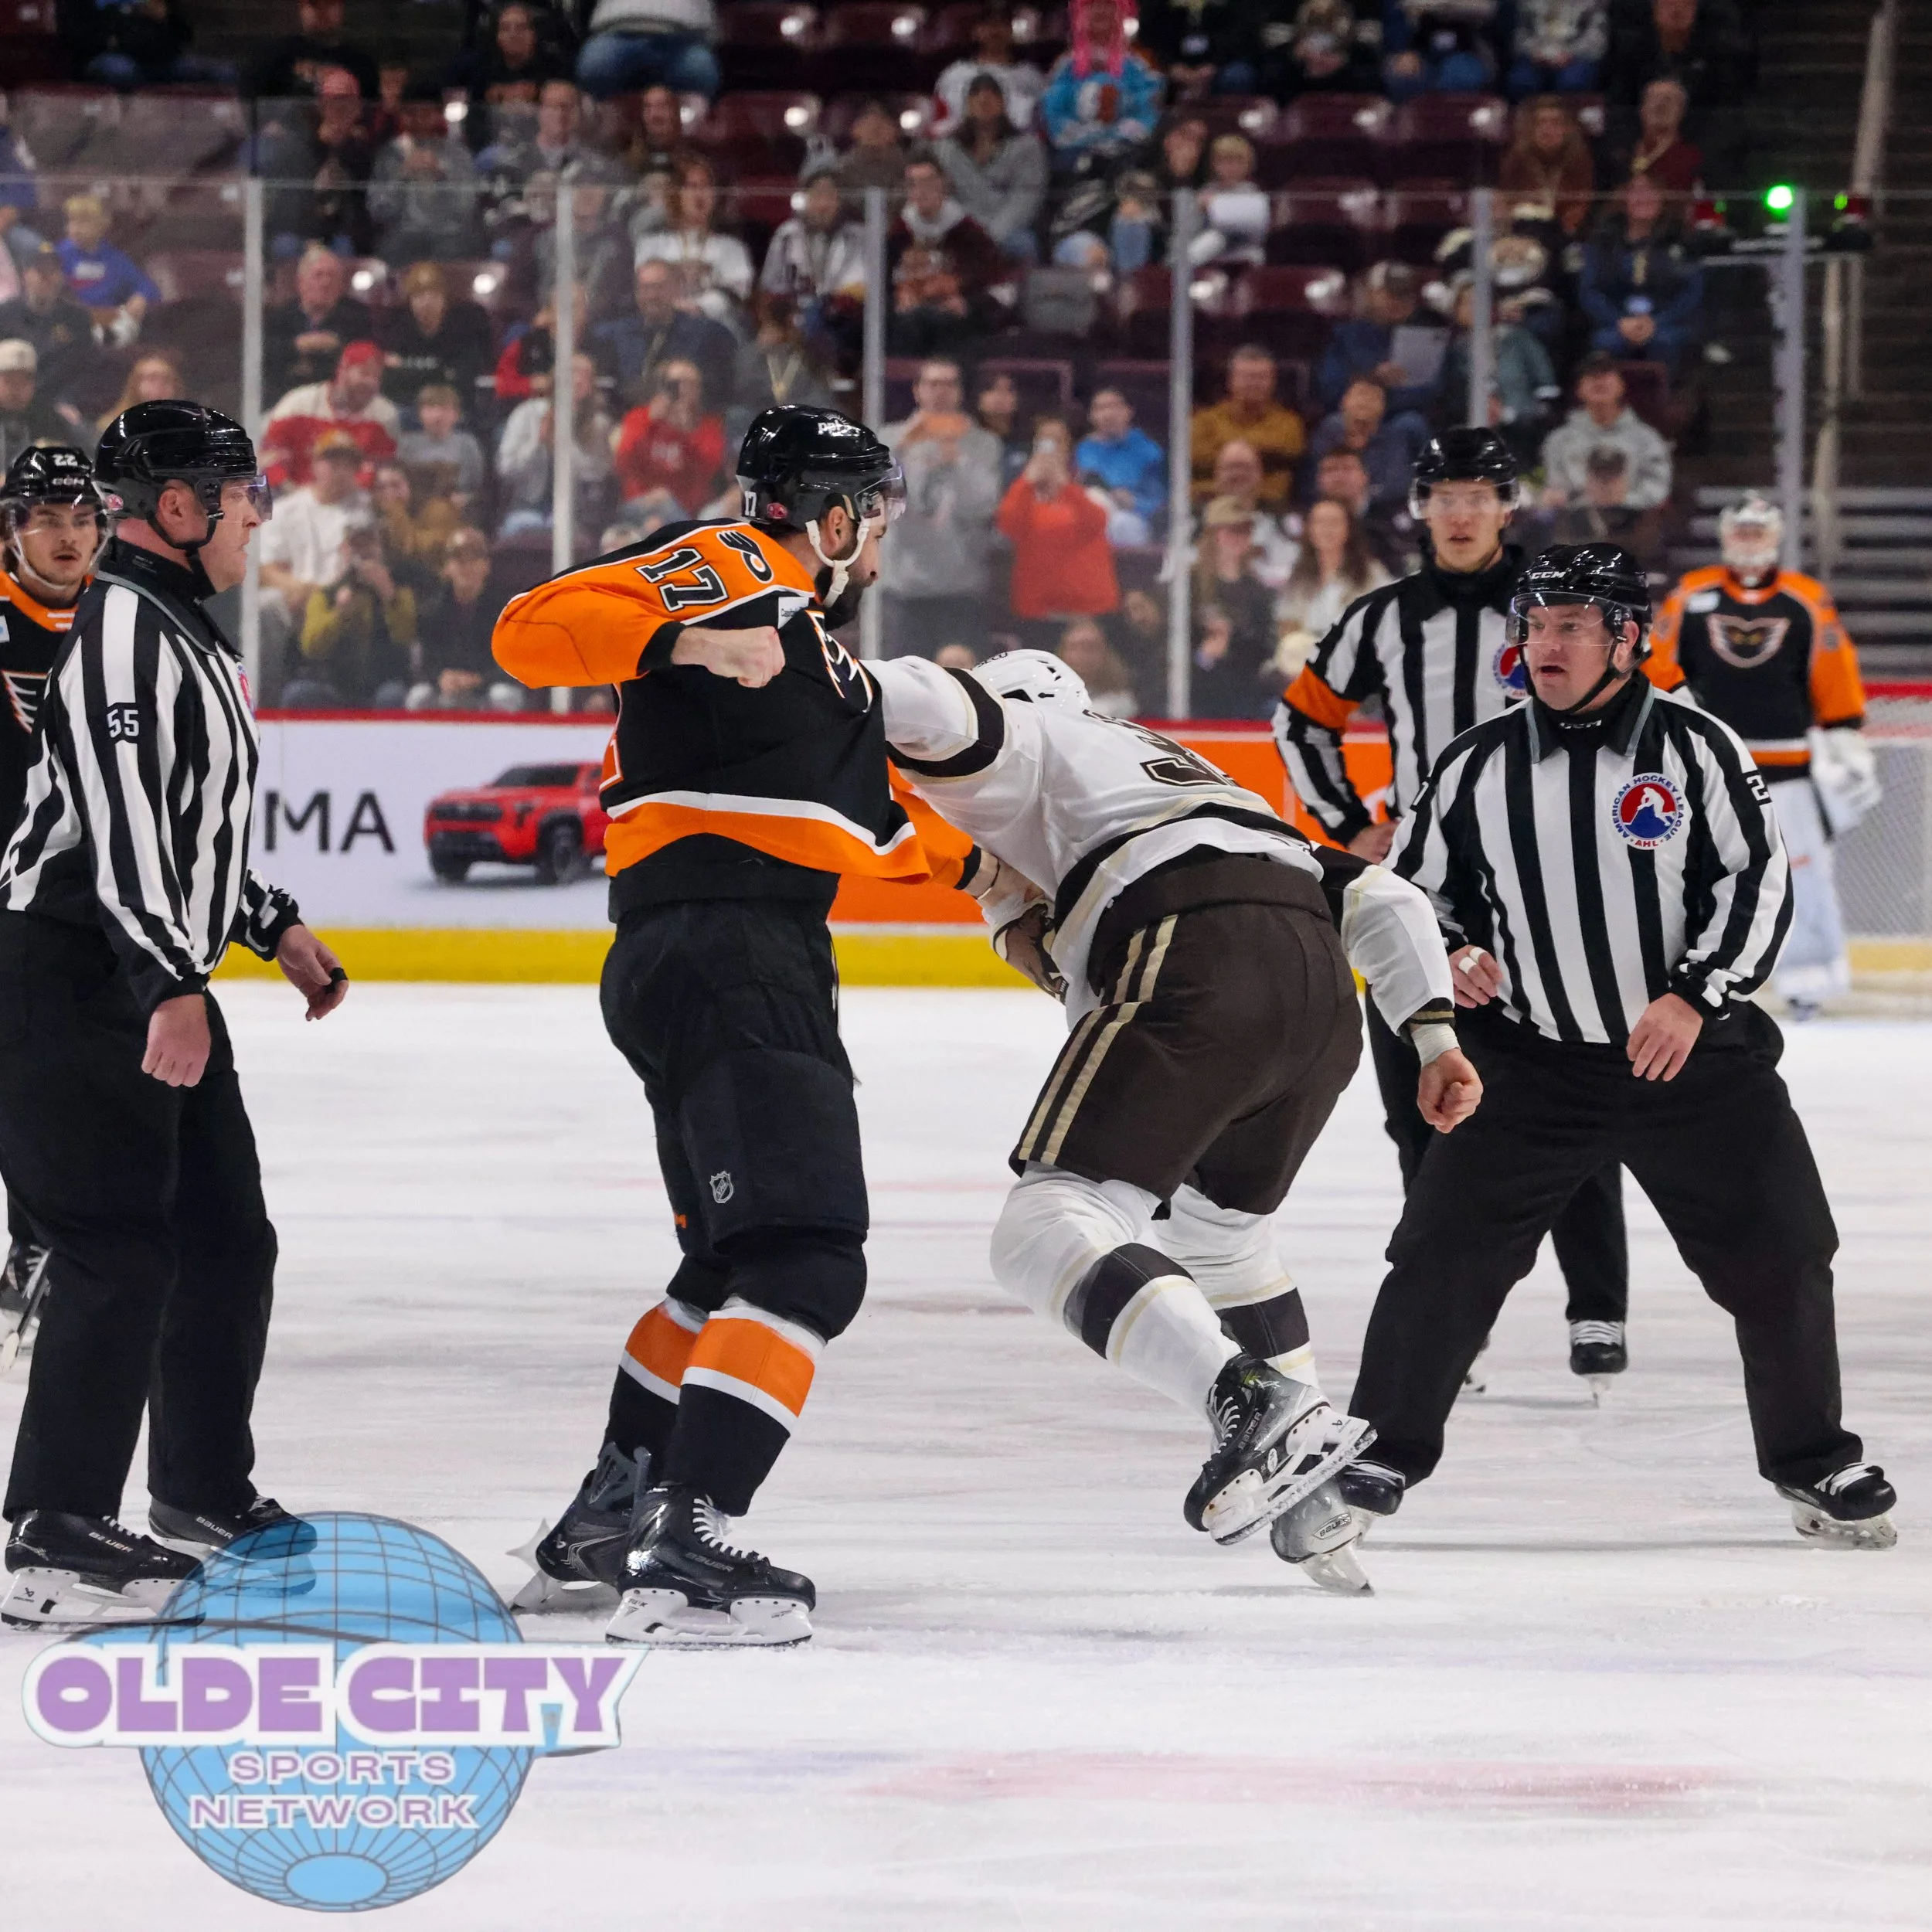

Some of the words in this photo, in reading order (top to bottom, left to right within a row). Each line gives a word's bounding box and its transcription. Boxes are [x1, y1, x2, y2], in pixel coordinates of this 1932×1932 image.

[51, 453, 78, 467] 22
[743, 490, 757, 517] 17
[634, 546, 730, 612] 17
[1530, 571, 1566, 580] CCM
[106, 708, 139, 738] 55
[252, 790, 396, 852] MA
[1611, 783, 1631, 838] AMERICAN
[1633, 775, 1679, 793] HOCKEY
[1663, 796, 1684, 841] LEAGUE
[196, 1516, 233, 1539] BAUER
